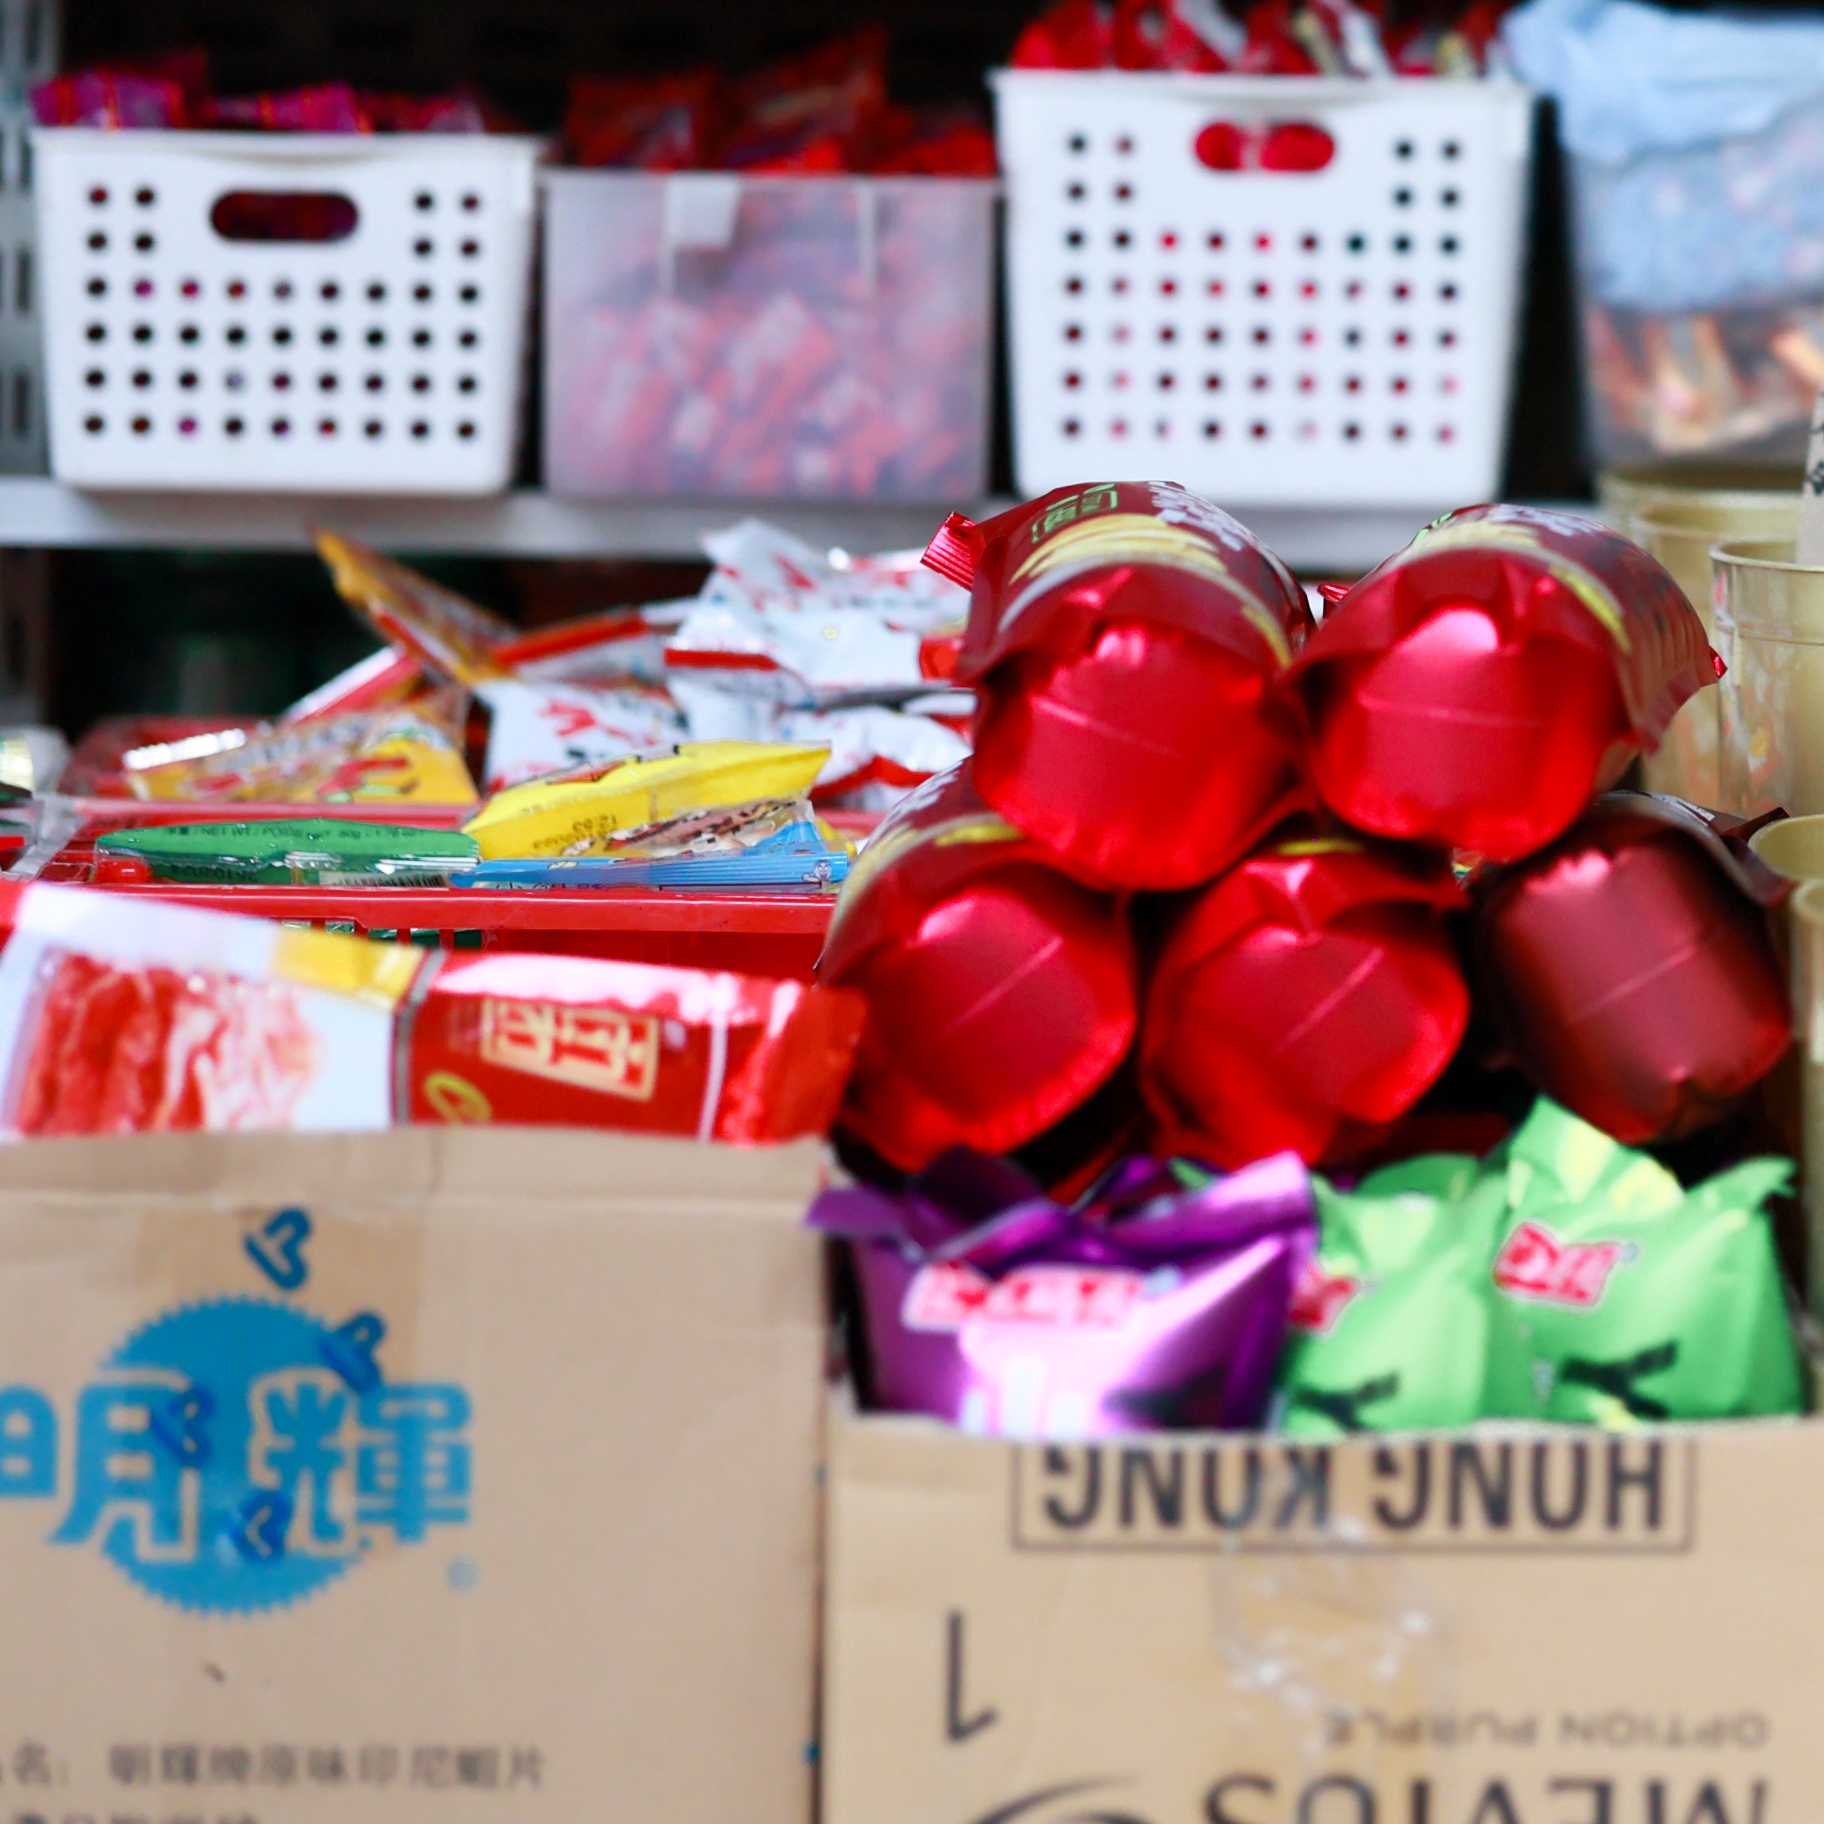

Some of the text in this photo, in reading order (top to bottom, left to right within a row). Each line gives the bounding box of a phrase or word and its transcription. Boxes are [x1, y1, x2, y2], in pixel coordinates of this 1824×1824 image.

[1043, 1439, 1667, 1534] HONG KONG
[1321, 1707, 1772, 1749] OPTION PURPLE
